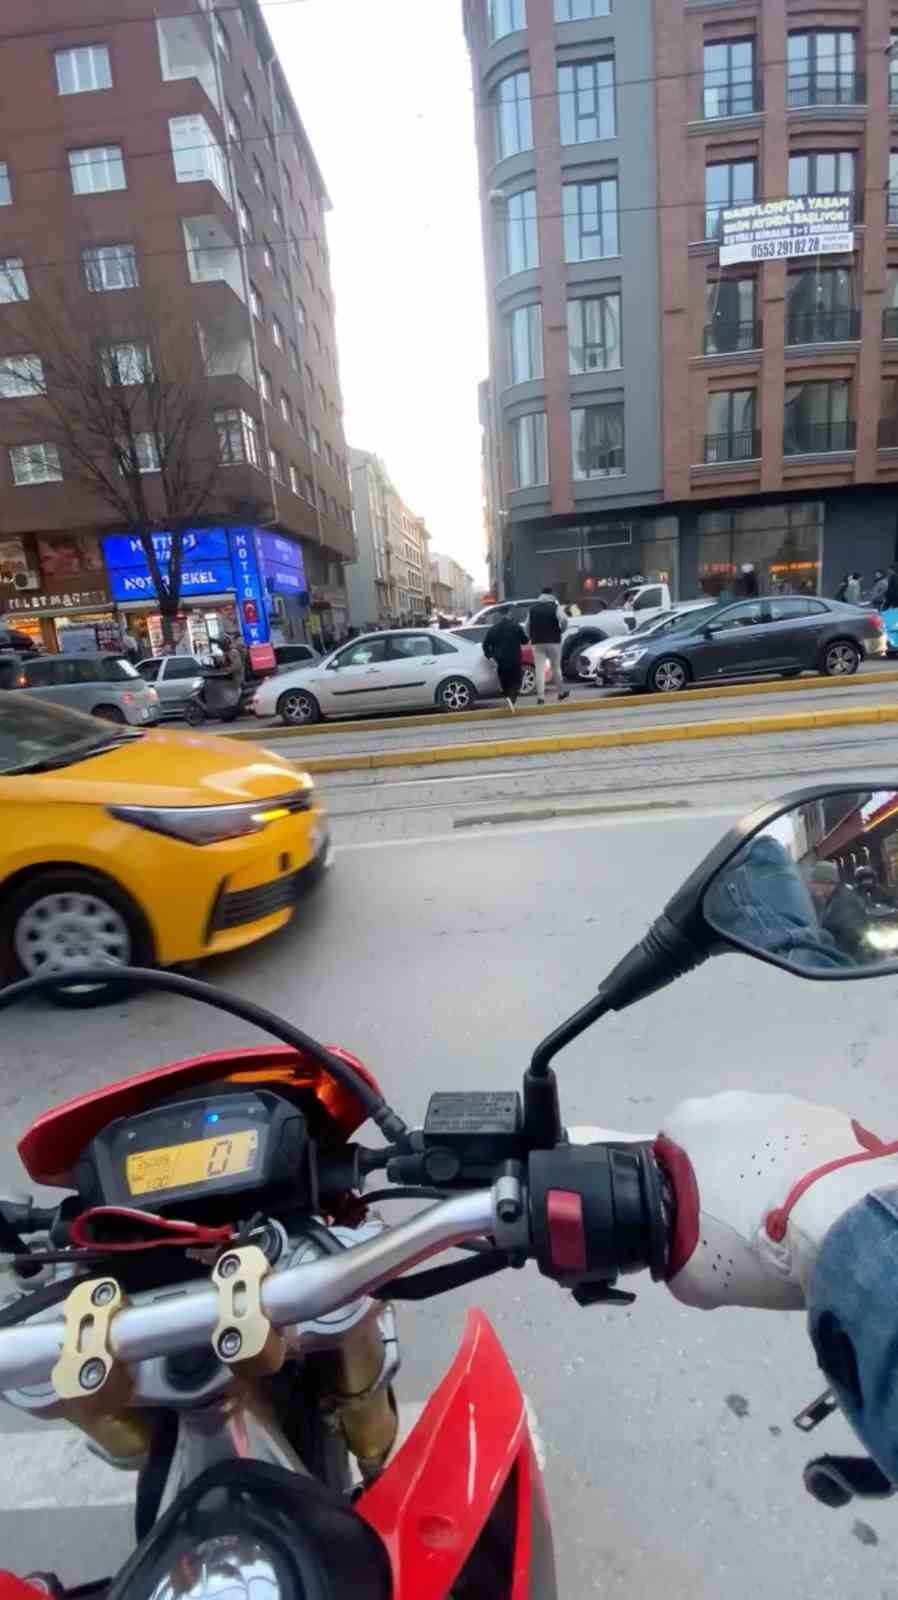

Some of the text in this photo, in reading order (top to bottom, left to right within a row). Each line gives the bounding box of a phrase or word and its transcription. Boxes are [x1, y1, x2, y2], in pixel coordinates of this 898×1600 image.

[751, 241, 775, 258] 0553
[777, 240, 793, 256] 291
[795, 238, 807, 254] 02
[178, 571, 217, 585] EKEL
